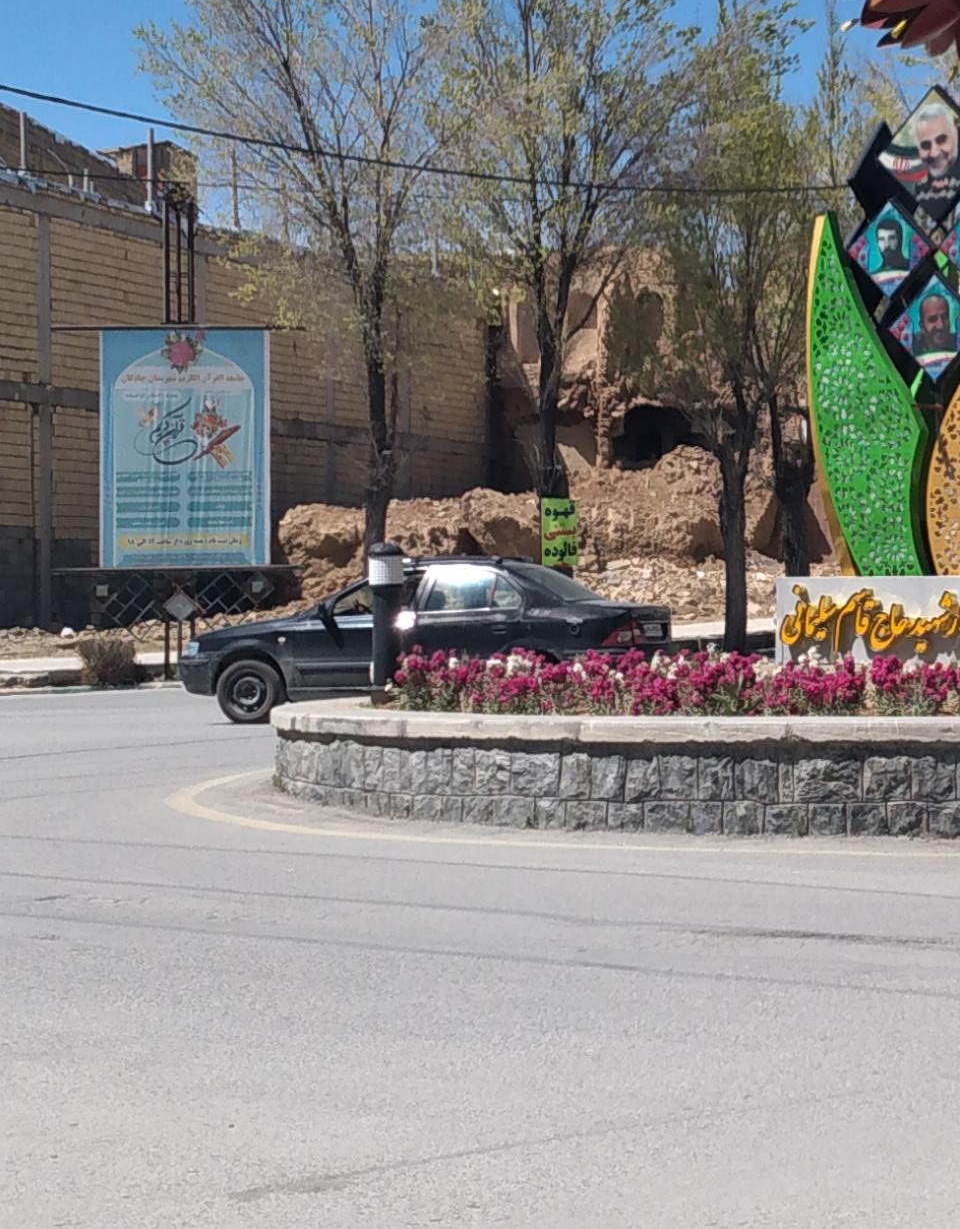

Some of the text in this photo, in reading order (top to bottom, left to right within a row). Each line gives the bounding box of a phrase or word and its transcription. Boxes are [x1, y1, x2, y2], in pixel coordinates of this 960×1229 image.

[544, 500, 576, 521] قهوه
[780, 584, 837, 646] سلیمانی
[833, 588, 876, 653] قاسم
[870, 603, 909, 652] حاج
[908, 590, 957, 654] شهید
